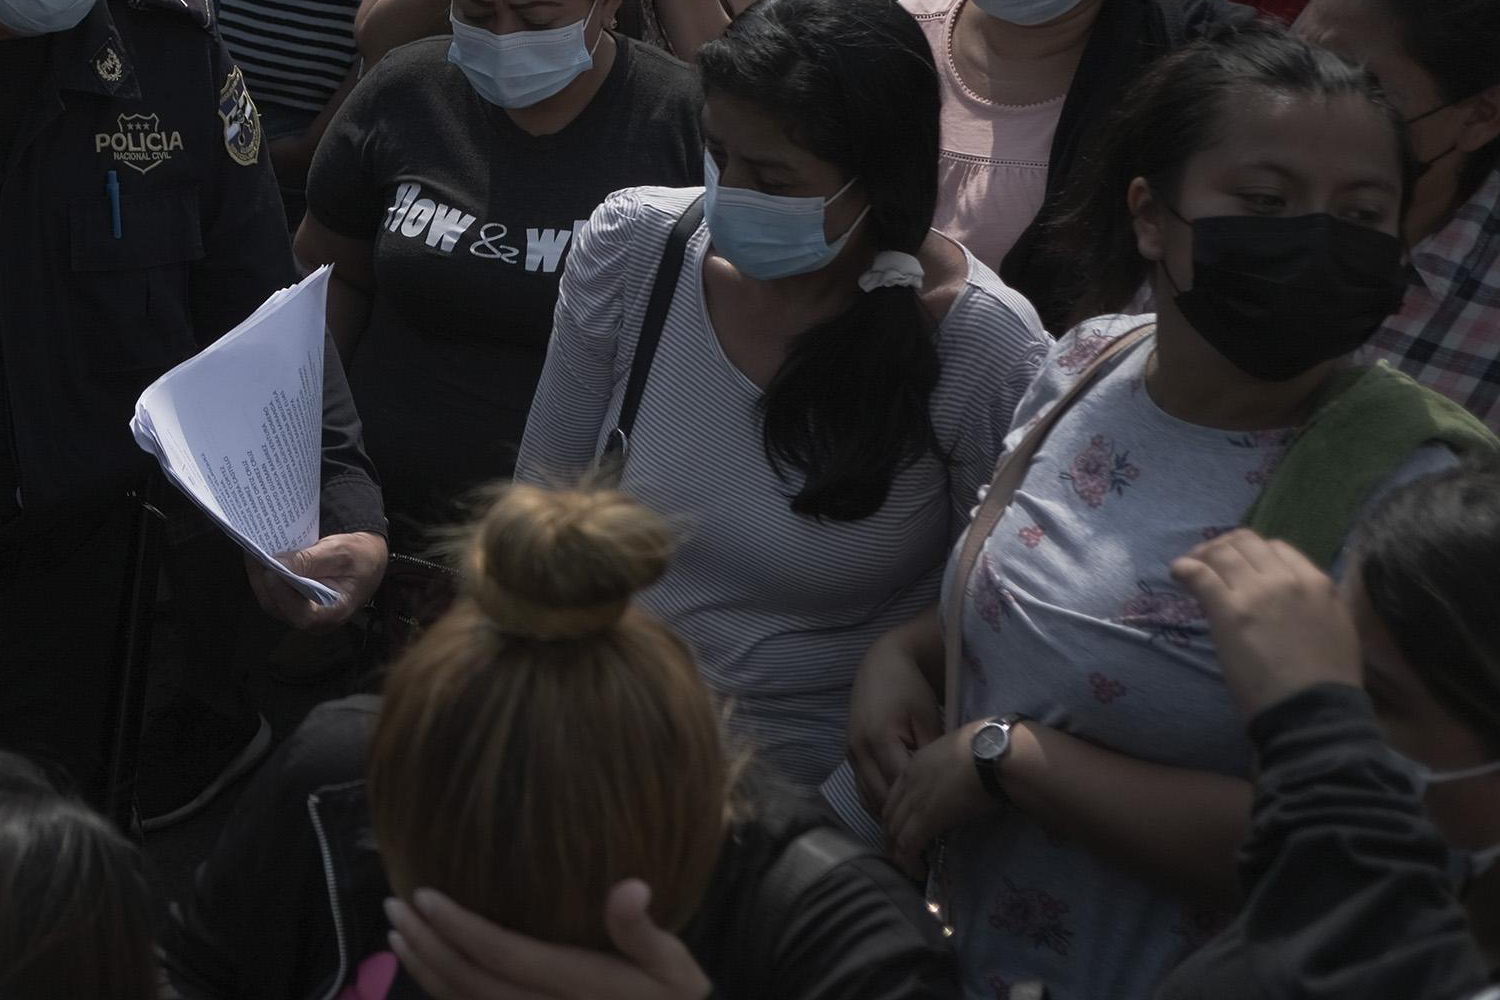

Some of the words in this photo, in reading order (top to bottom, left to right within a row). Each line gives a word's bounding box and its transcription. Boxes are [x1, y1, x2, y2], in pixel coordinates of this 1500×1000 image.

[95, 130, 184, 153] POLICIA
[113, 151, 151, 161] NACIONAL
[151, 151, 173, 160] CIVIL
[469, 222, 520, 264] &
[261, 405, 278, 435] ROMERO
[259, 421, 277, 455] VENTURA
[273, 433, 288, 464] GUEVARA
[222, 454, 238, 484] CASTILLO
[240, 459, 253, 477] CRUZ
[245, 449, 257, 467] CRUZ
[260, 442, 276, 472] RAMIREZ
[247, 475, 260, 496] ORTIZ
[252, 466, 269, 495] RAMIREZ
[259, 461, 276, 492] GUZMAN
[271, 470, 285, 495] GARCIA
[234, 483, 248, 507] RIVERA
[243, 484, 259, 514] RAMIREZ
[263, 493, 281, 525] EDGARDO
[270, 490, 284, 512] DAVID
[279, 510, 291, 528] RAUL
